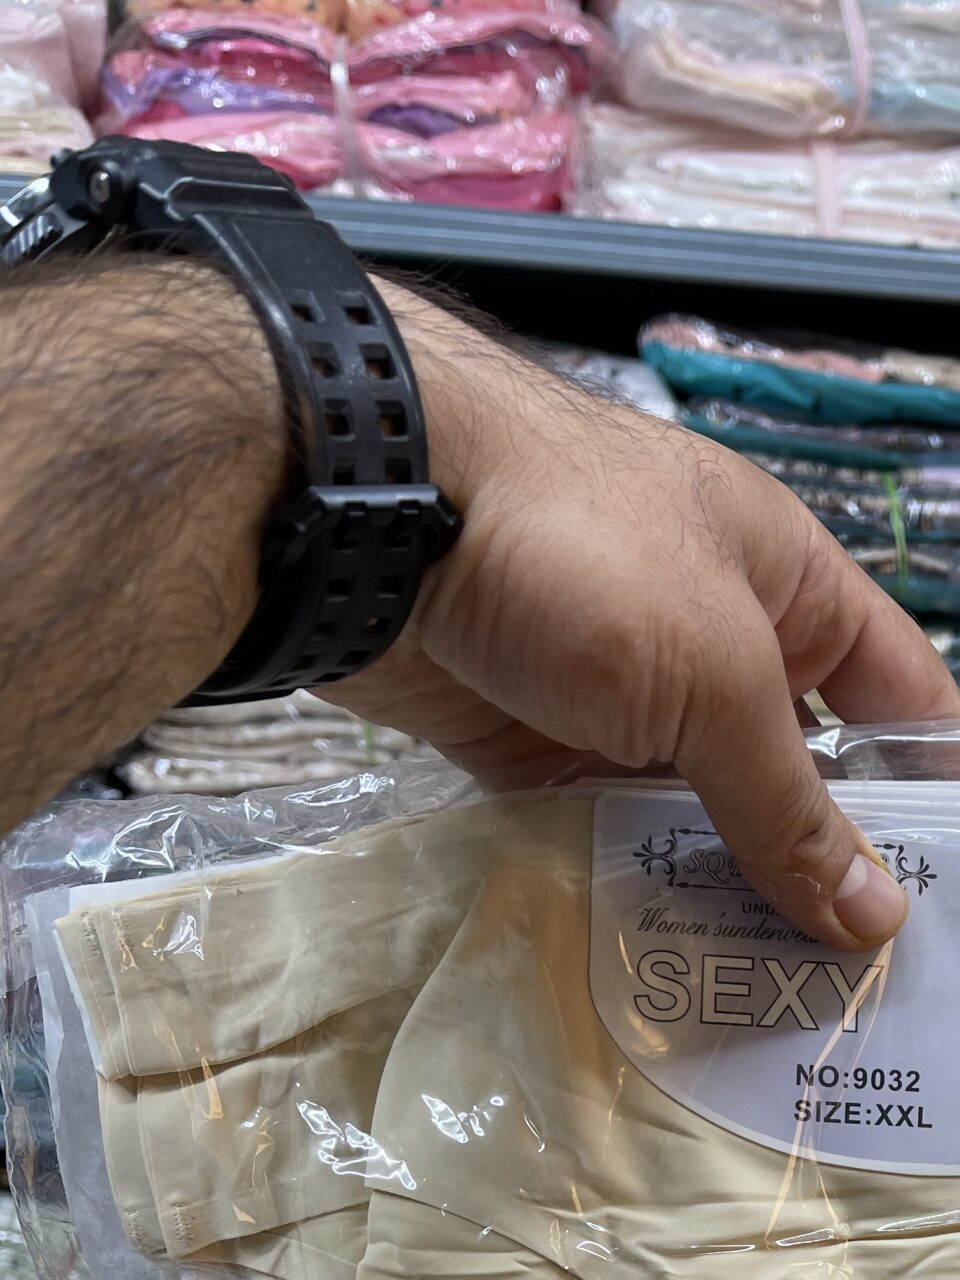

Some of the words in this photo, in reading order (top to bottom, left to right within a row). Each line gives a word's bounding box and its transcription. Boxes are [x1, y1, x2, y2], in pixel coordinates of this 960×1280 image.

[637, 906, 709, 936] Women
[633, 949, 884, 1033] SEXY
[795, 1063, 921, 1093] NO:9032
[793, 1099, 933, 1129] SIZE:XXL
